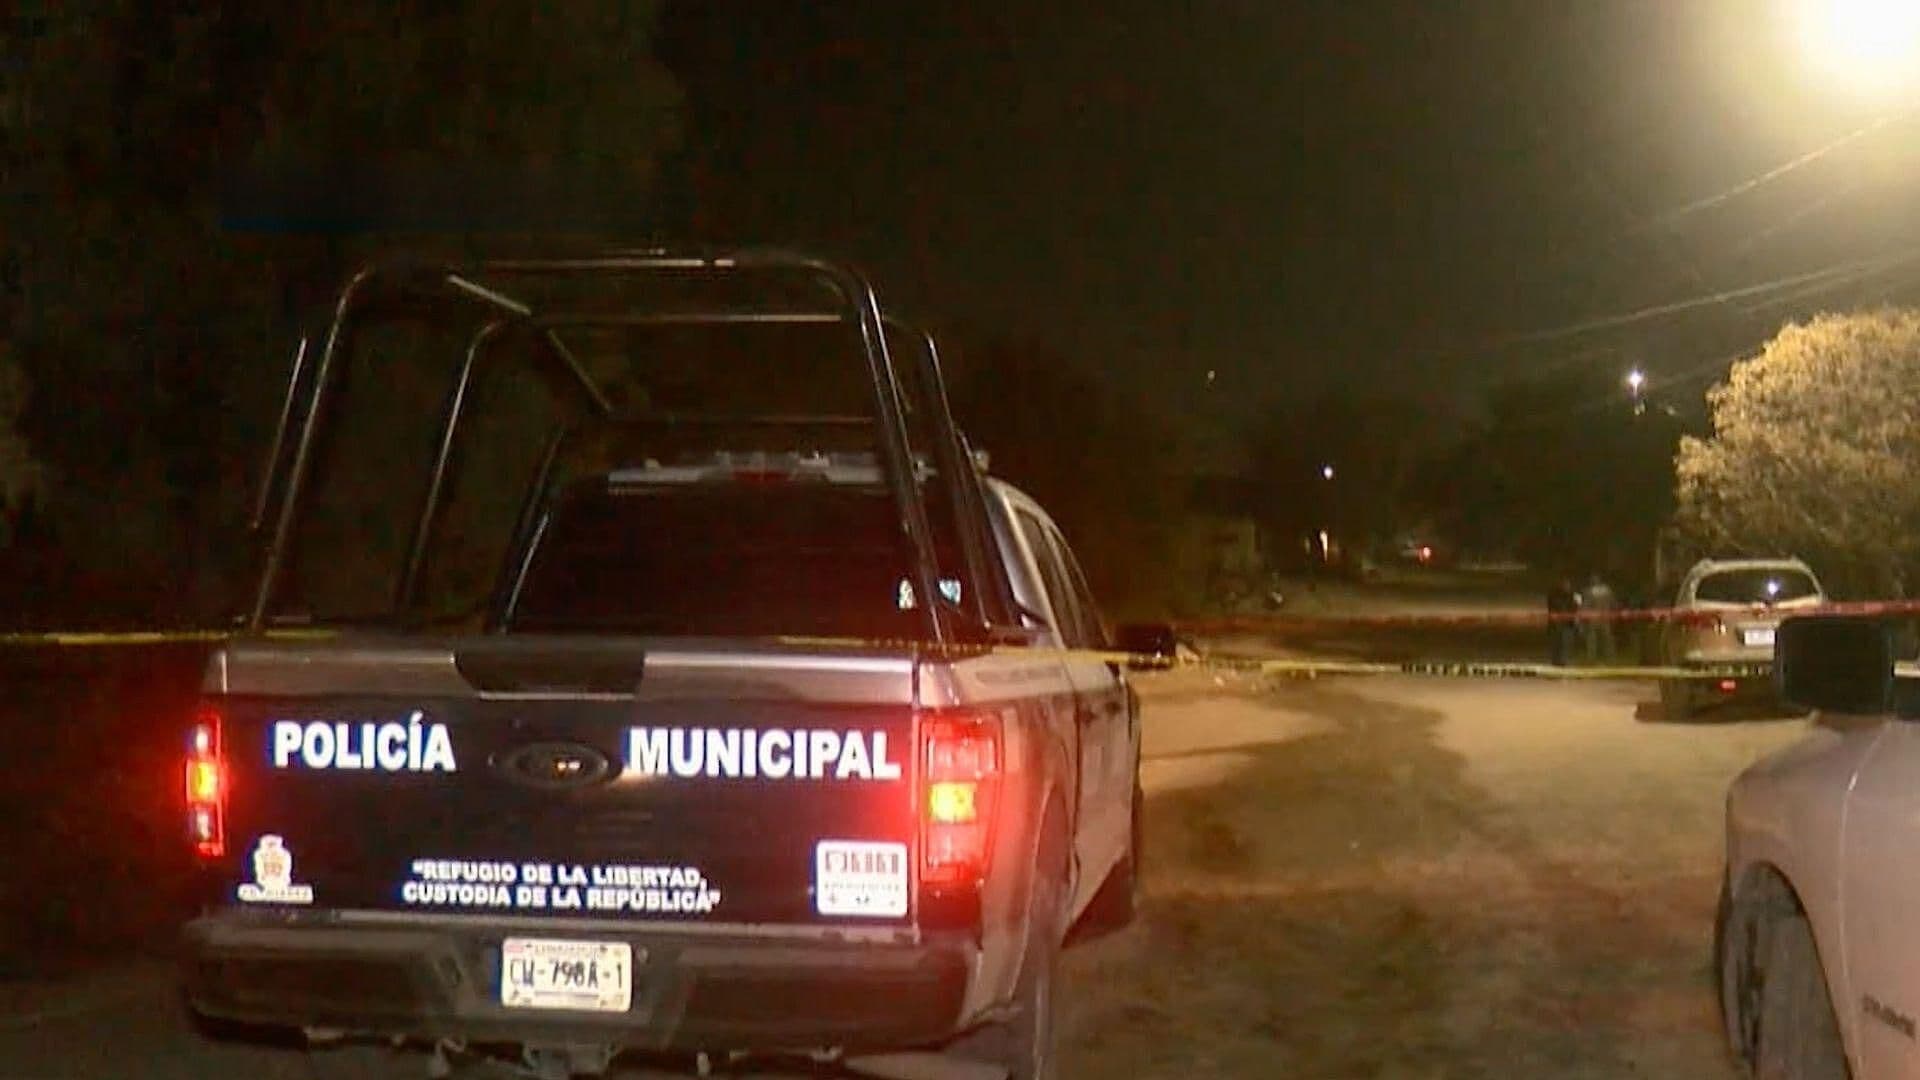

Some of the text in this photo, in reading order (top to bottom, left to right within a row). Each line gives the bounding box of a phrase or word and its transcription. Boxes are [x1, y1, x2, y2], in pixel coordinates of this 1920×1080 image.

[275, 711, 901, 780] POLICÍA MUNICIPAL
[522, 863, 553, 883] DE
[557, 864, 588, 885] LA
[592, 864, 708, 891] LIBERTAD,
[402, 881, 511, 904] CUSTODIA
[516, 885, 546, 907] DE
[551, 886, 582, 908] LA
